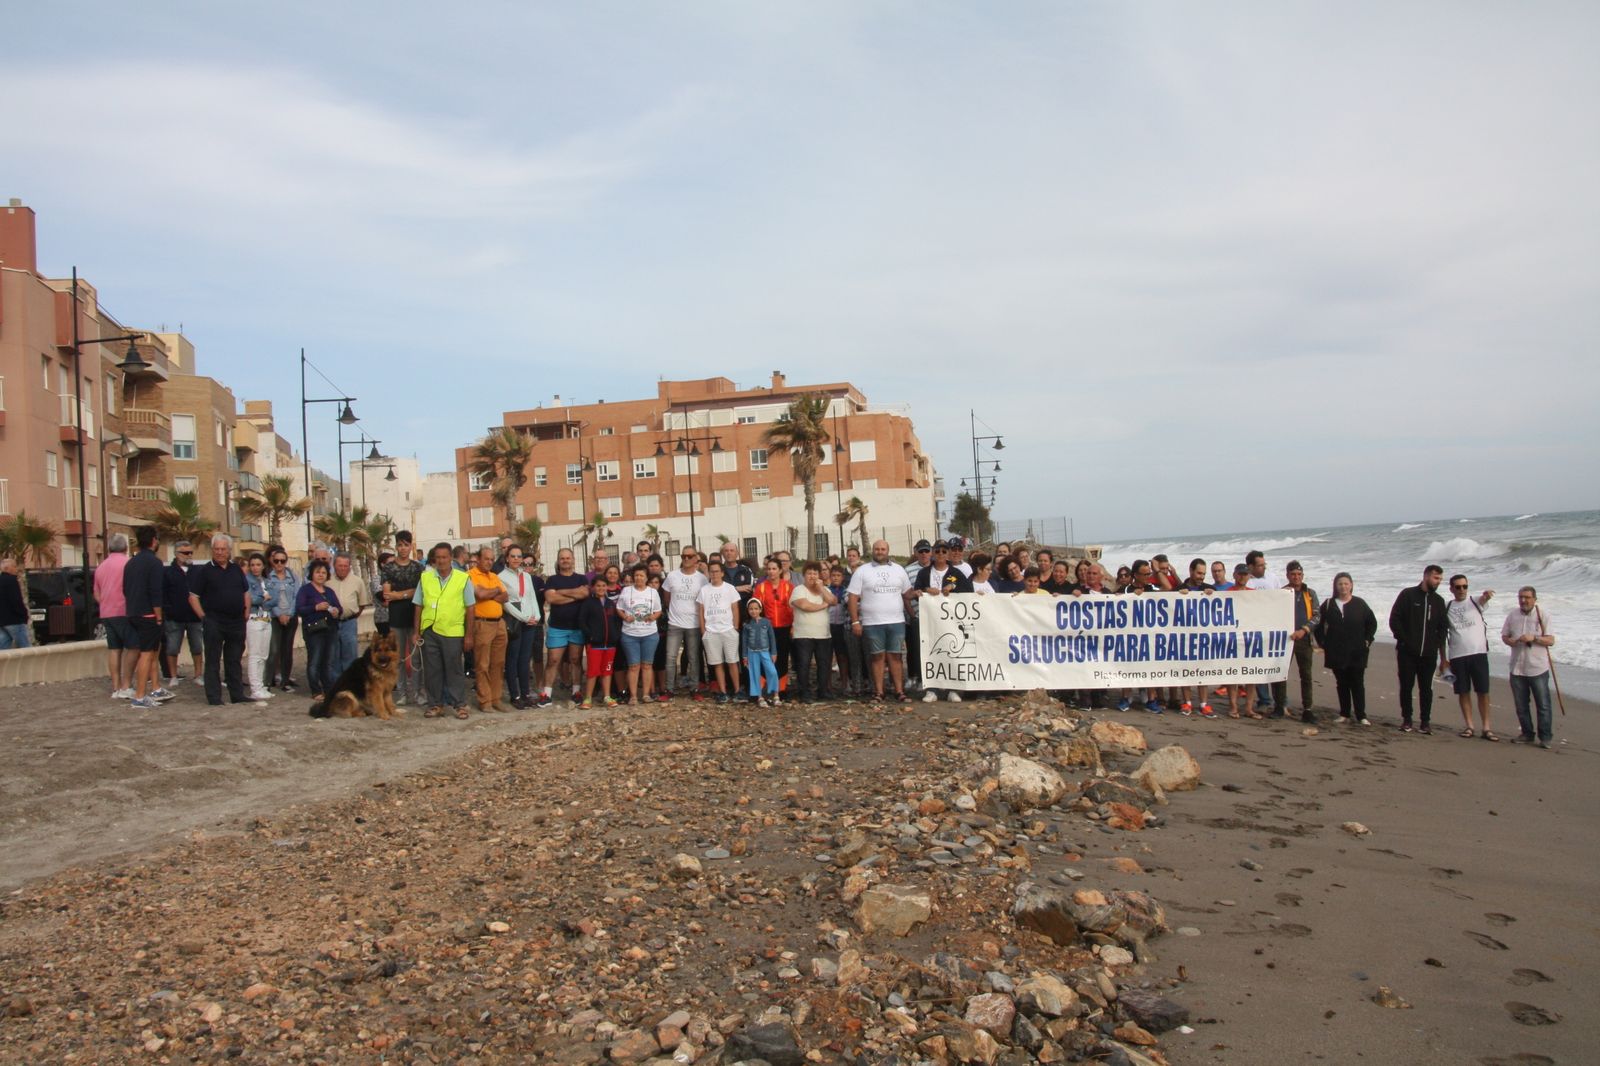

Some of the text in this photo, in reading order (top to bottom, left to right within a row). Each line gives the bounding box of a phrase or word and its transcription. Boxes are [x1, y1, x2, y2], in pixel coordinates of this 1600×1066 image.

[940, 601, 981, 621] S.O.S
[1056, 597, 1239, 630] COSTAS NOS AHOGA,
[1008, 630, 1288, 664] SOLUCIÓN PARA BALERMA YA !!!
[925, 661, 1005, 682] BALERMA
[1150, 671, 1167, 680] por
[1170, 669, 1179, 678] la
[1182, 667, 1222, 678] Defensa
[1226, 667, 1238, 676] de
[1241, 665, 1281, 675] Balerma
